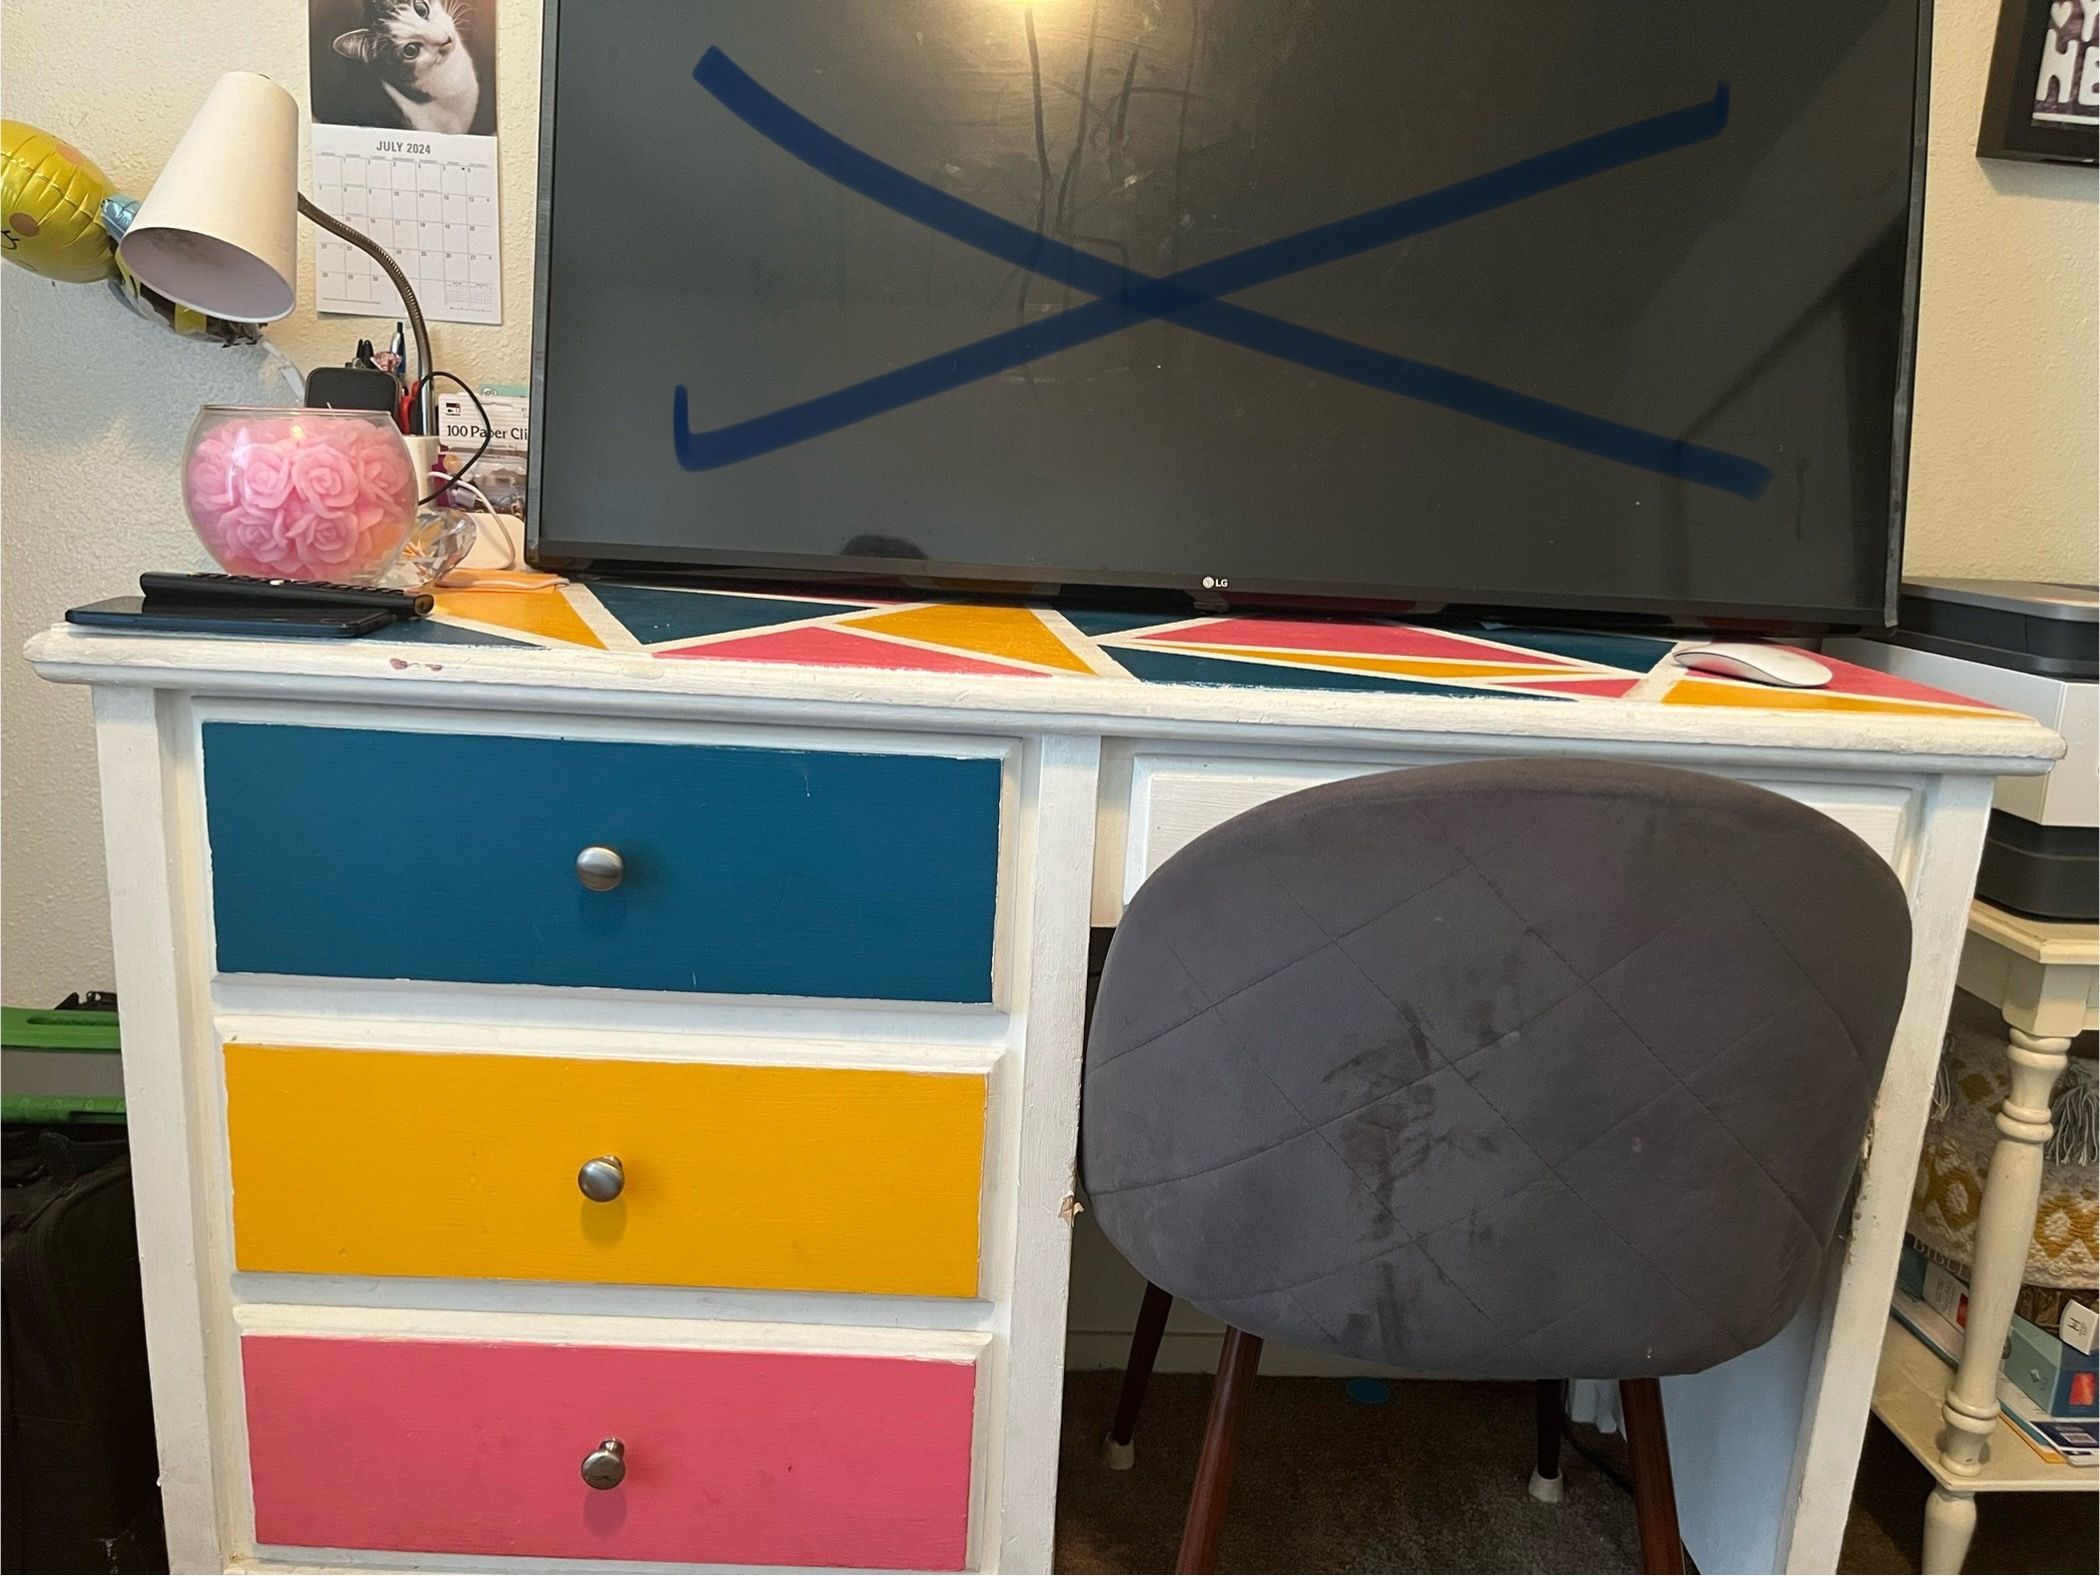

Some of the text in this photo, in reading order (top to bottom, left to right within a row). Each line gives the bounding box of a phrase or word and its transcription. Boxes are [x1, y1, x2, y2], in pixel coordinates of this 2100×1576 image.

[376, 140, 431, 154] JULY 2024
[447, 424, 468, 437] 100
[1215, 578, 1228, 588] LG
